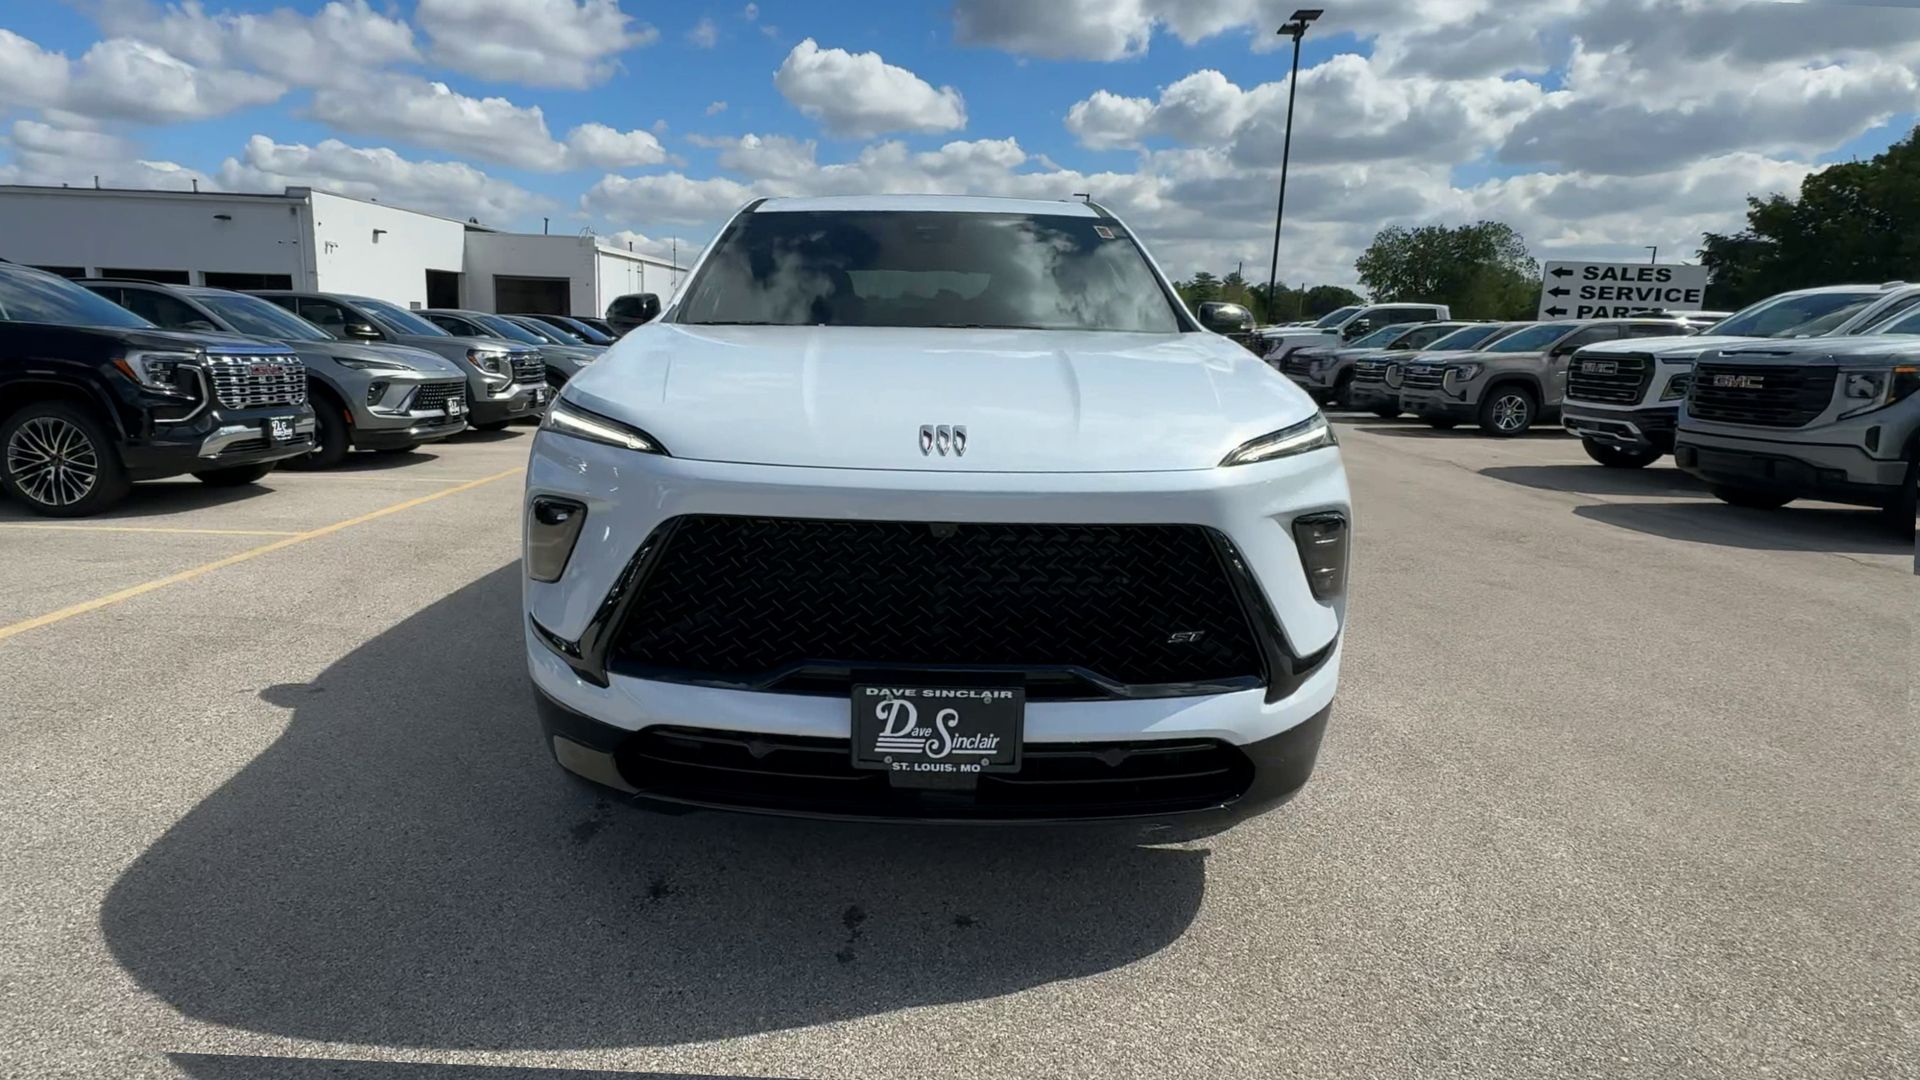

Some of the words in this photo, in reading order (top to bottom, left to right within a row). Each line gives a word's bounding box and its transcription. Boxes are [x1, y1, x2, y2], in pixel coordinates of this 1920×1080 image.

[1583, 266, 1672, 282] SALES
[1579, 285, 1700, 303] SERVICE
[1576, 305, 1665, 319] PAR
[1713, 374, 1764, 389] GMC
[866, 688, 916, 697] DAVE
[922, 689, 1013, 699] SINCLAIR
[875, 699, 932, 737] Dave
[925, 708, 1000, 758] Sinclair
[892, 762, 910, 771] ST.
[960, 764, 981, 773] MO
